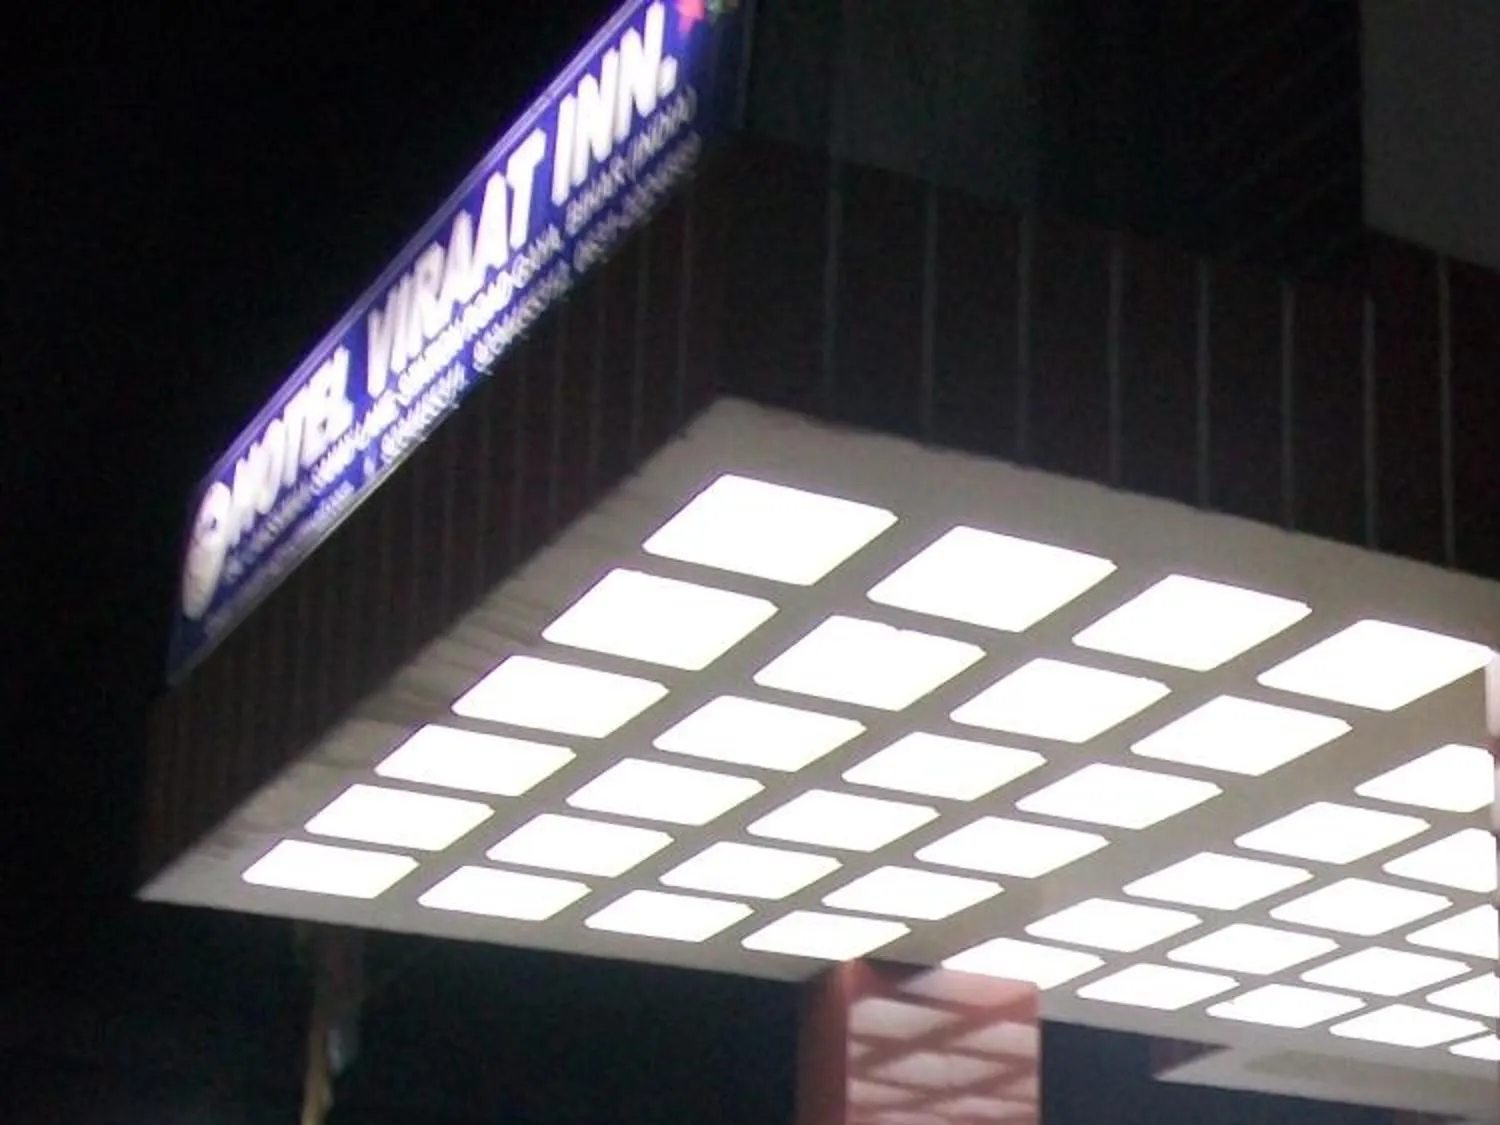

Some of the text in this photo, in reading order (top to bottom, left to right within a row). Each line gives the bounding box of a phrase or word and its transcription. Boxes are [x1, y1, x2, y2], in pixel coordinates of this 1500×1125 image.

[228, 345, 354, 547] HOTEL
[366, 127, 547, 400] VIRAAT
[551, 2, 678, 207] INN.
